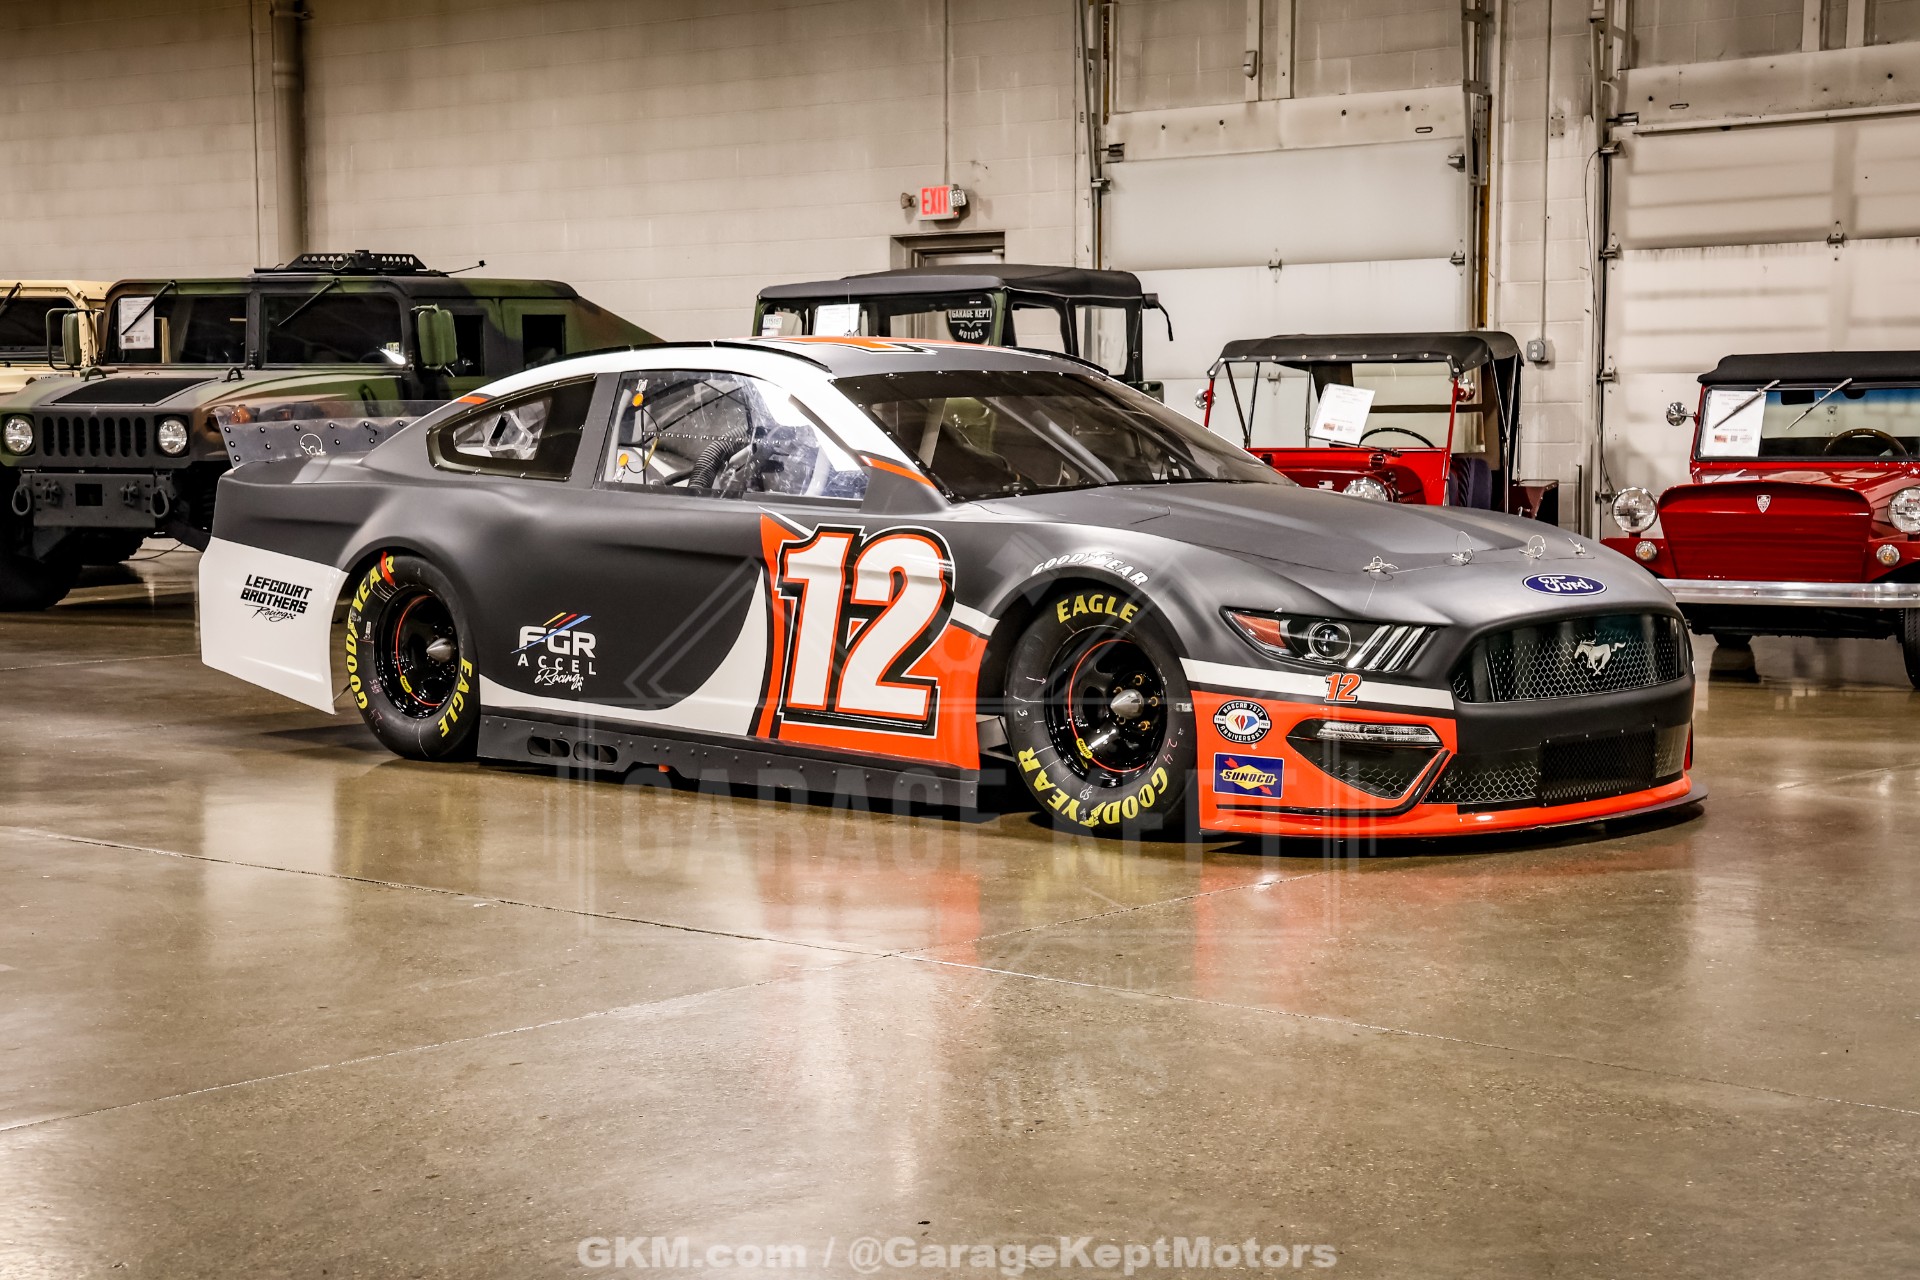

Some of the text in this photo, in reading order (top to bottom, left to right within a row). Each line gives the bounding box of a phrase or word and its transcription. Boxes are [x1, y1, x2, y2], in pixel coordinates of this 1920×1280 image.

[921, 186, 949, 215] EXIT
[952, 308, 990, 319] GARAGE KEPT
[958, 328, 983, 340] MOTORS
[1031, 550, 1149, 586] GOODYEAR
[245, 574, 313, 599] LEFCOURT
[1538, 576, 1593, 592] Ford
[240, 587, 308, 614] BROTHERS
[1056, 594, 1138, 624] EAGLE
[518, 625, 597, 659] FGR
[780, 527, 952, 732] 12
[517, 653, 597, 676] ACCEL
[437, 657, 473, 737] EAGLE
[1325, 673, 1361, 703] 12
[1222, 702, 1248, 714] NASCAR
[1220, 725, 1264, 741] ANNIVERSARY
[1018, 747, 1168, 828] GOODYEAR
[1223, 770, 1275, 785] SUNOCO
